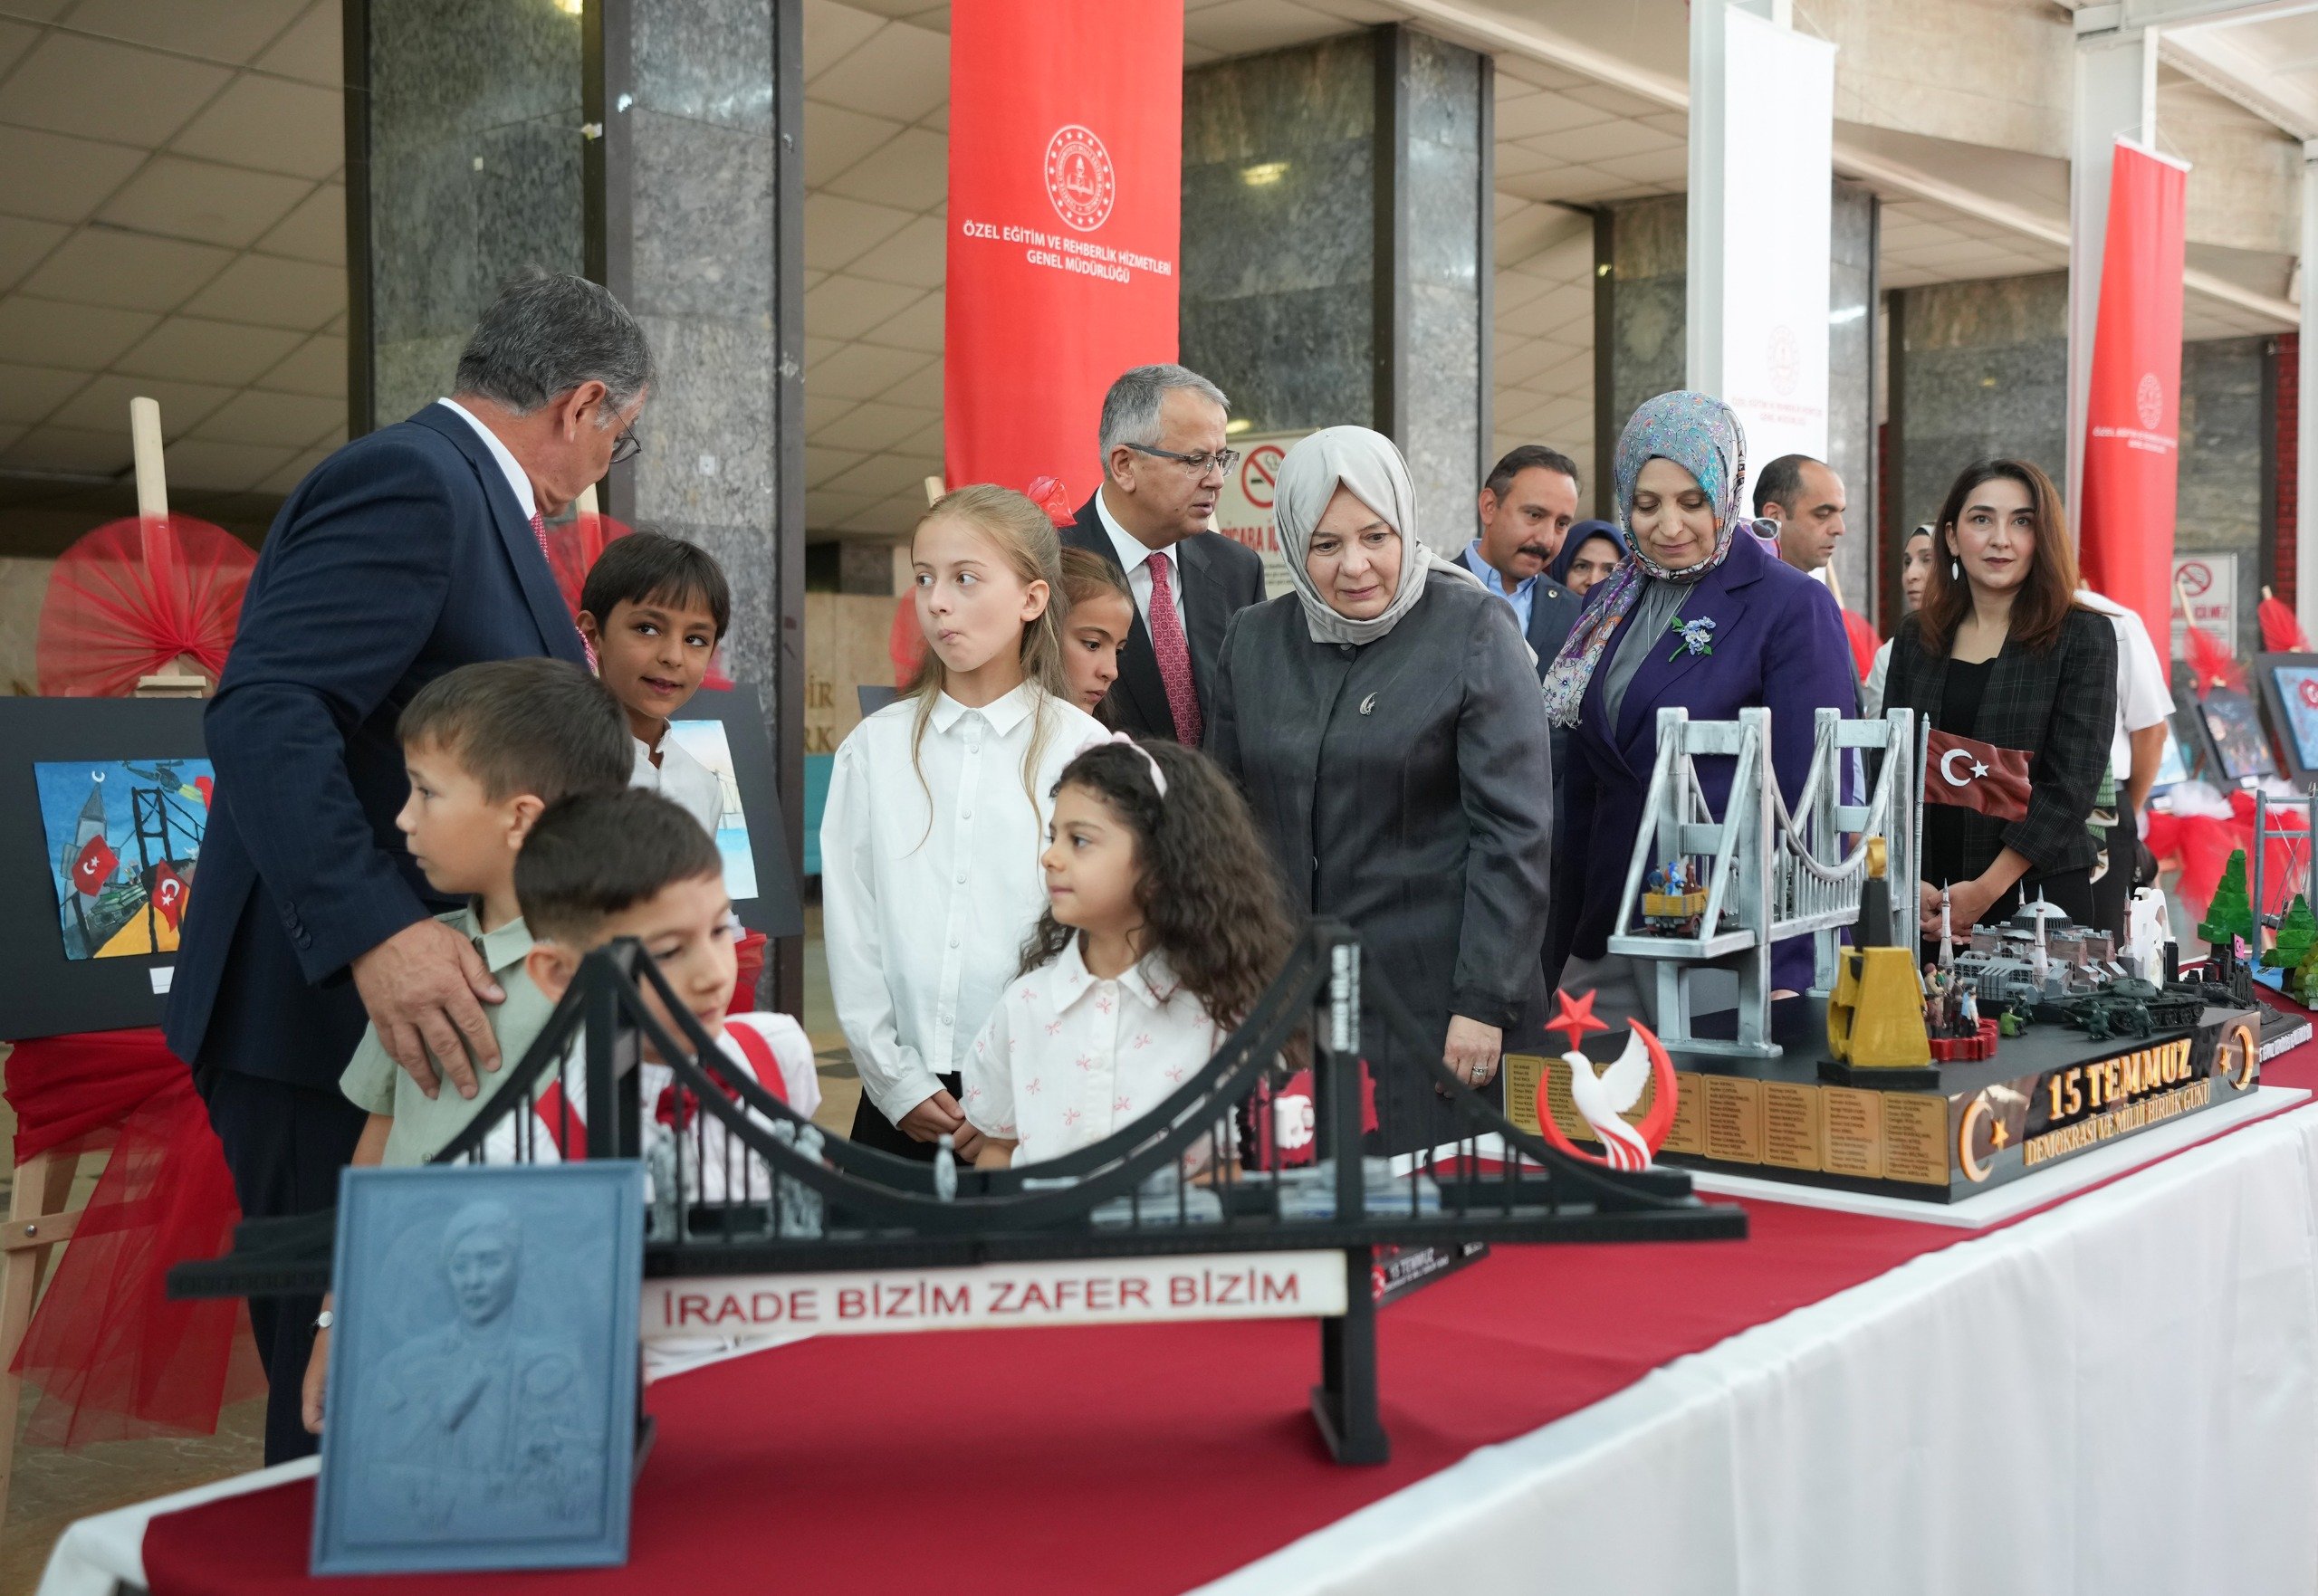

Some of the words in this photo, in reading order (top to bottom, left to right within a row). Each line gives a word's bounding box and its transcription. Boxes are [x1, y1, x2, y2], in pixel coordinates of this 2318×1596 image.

[963, 220, 1001, 240] ÖZEL
[1003, 225, 1045, 247] EĞİTİM
[1047, 234, 1061, 251] VE
[1063, 237, 1116, 263] REHBERLİK
[1118, 249, 1172, 276] HİZMETLERİ
[1026, 249, 1063, 270] GENEL
[1065, 256, 1131, 284] MÜDÜRLÜĞÜ
[2048, 1066, 2082, 1121] 15
[2086, 1037, 2192, 1107] TEMMUZ
[2023, 1112, 2097, 1167] DEMOKRASİ
[2096, 1113, 2114, 1141] VE
[2180, 1076, 2211, 1110] GÜNÜ
[665, 1290, 819, 1326] İRADE
[838, 1280, 971, 1318] BİZİM
[988, 1277, 1150, 1313] ZAFER
[1168, 1269, 1299, 1306] BİZİM
